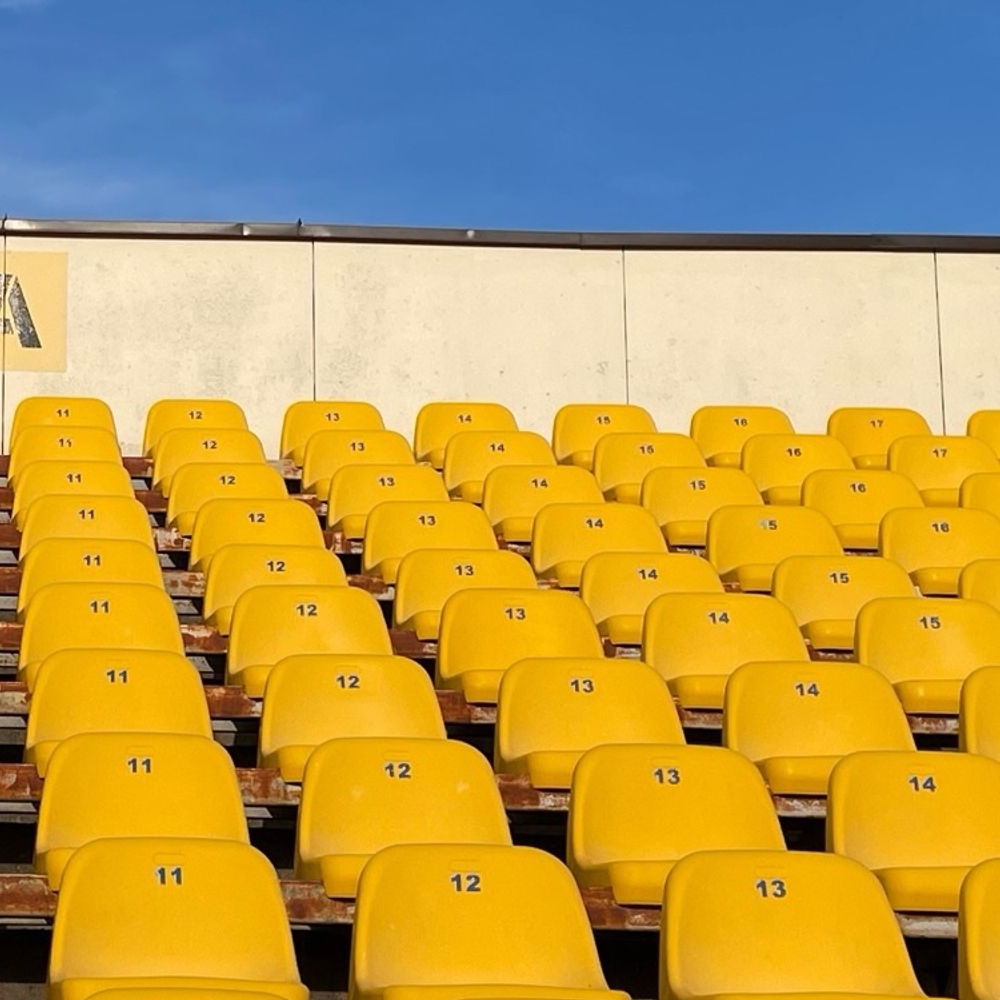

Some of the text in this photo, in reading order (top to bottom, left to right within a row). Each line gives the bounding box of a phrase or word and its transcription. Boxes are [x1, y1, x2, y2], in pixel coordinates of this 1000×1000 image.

[56, 408, 70, 418] 11
[188, 410, 203, 420] 12
[325, 412, 340, 422] 13
[458, 414, 473, 424] 14
[870, 419, 884, 428] 17
[202, 440, 218, 450] 12
[350, 441, 366, 452] 13
[489, 442, 505, 453] 14
[786, 447, 802, 457] 16
[932, 448, 948, 458] 17
[66, 473, 82, 484] 11
[219, 474, 236, 486] 12
[378, 476, 396, 487] 13
[531, 478, 549, 489] 14
[689, 479, 707, 491] 15
[849, 482, 867, 493] 16
[78, 508, 95, 520] 11
[247, 512, 266, 523] 12
[418, 514, 437, 527] 13
[585, 517, 604, 529] 14
[82, 554, 101, 567] 11
[266, 560, 286, 573] 12
[454, 564, 475, 577] 13
[638, 568, 659, 581] 14
[829, 572, 850, 584] 15
[89, 599, 110, 614] 11
[295, 603, 318, 617] 12
[504, 607, 527, 621] 13
[707, 611, 730, 625] 14
[919, 615, 942, 630] 15
[106, 669, 128, 684] 11
[336, 675, 360, 689] 12
[571, 679, 594, 693] 13
[795, 682, 821, 697] 14
[128, 758, 151, 773] 11
[385, 763, 411, 779] 12
[654, 768, 680, 785] 13
[909, 776, 936, 792] 14
[155, 867, 182, 885] 11
[451, 874, 481, 892] 12
[756, 879, 786, 898] 13
